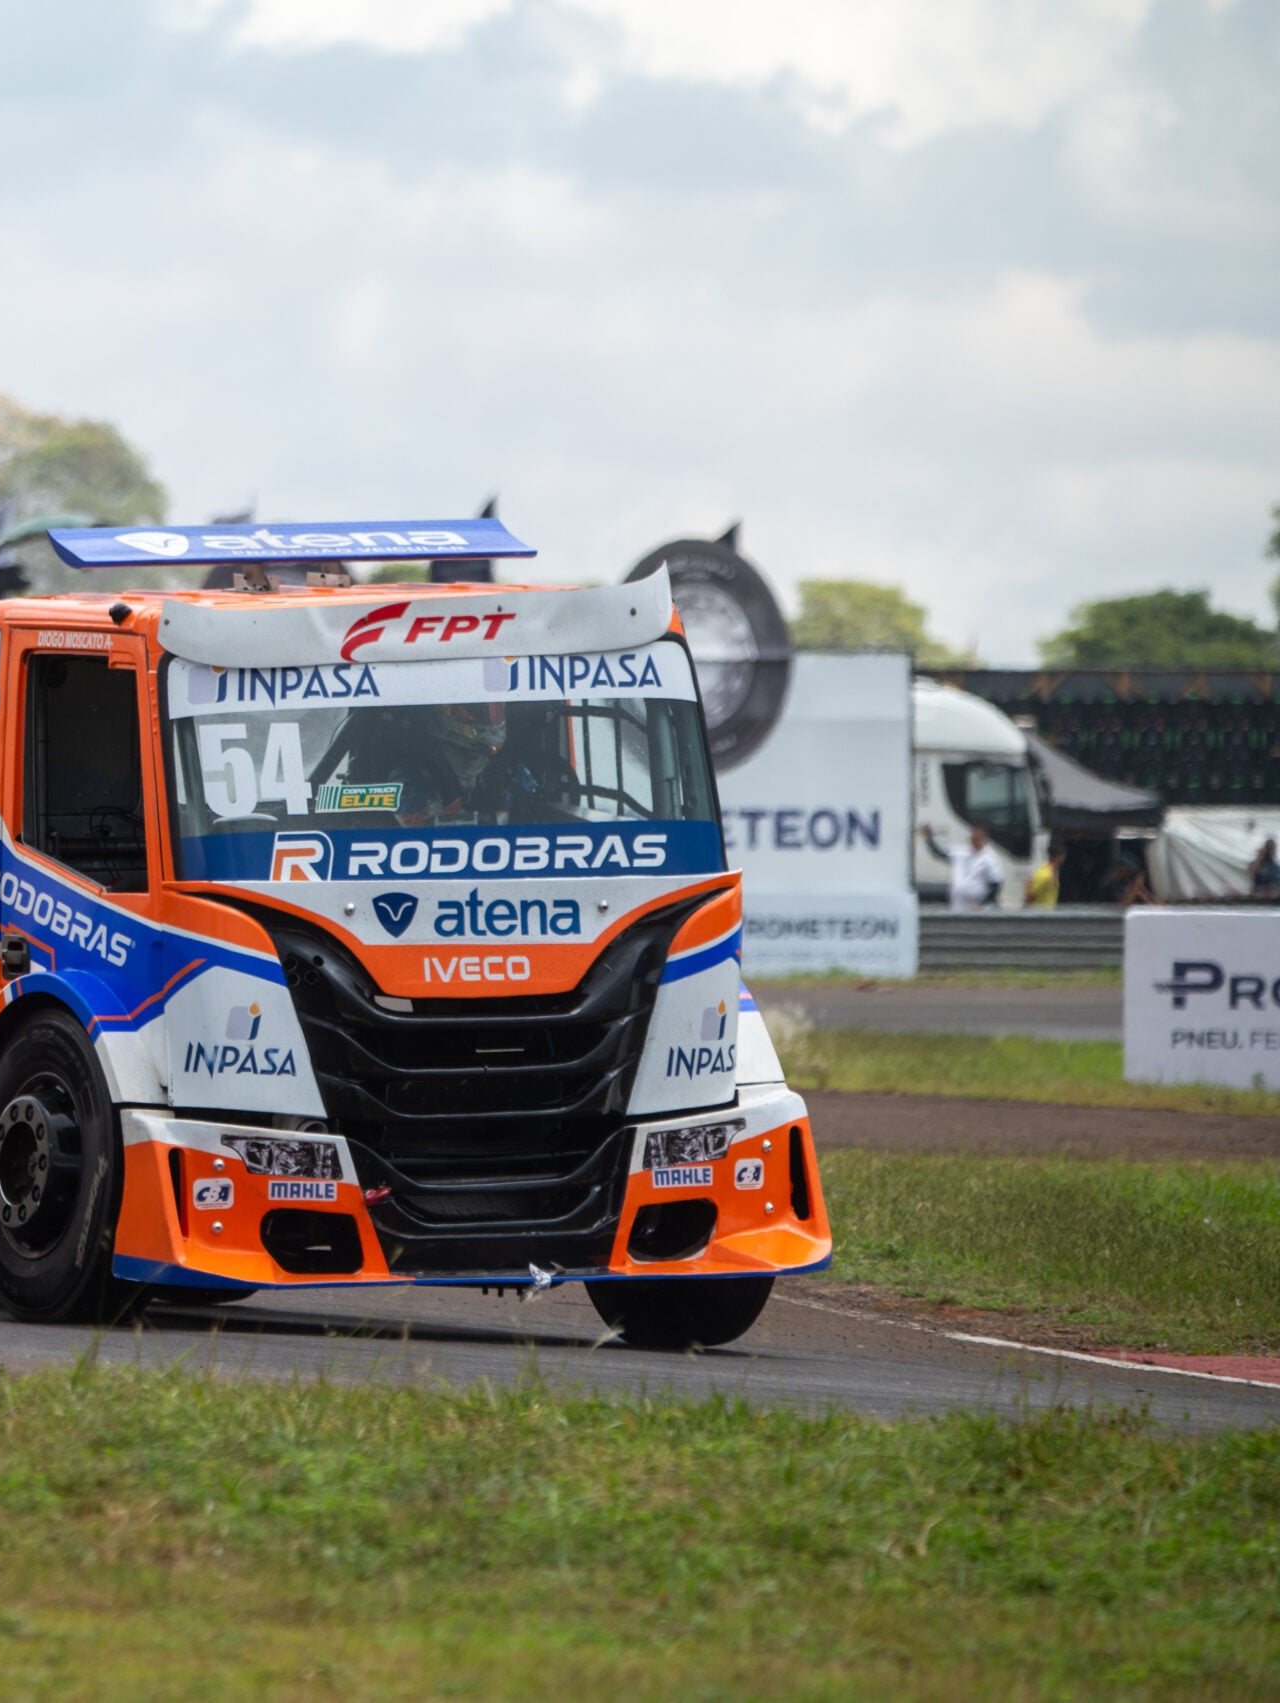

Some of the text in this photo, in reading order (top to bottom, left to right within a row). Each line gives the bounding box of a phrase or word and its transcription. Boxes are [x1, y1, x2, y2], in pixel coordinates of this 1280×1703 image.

[201, 528, 469, 551] atena
[37, 631, 64, 647] DIOGO
[65, 632, 103, 649] MOSCATO
[404, 613, 517, 643] FPT
[238, 663, 381, 708] INPASA
[529, 654, 663, 696] INPASA
[199, 722, 312, 818] 54
[341, 794, 395, 807] ELITE
[348, 834, 668, 877] RODOBRAS
[434, 887, 581, 937] atena
[423, 955, 531, 983] IVECO
[1152, 961, 1280, 1010] PR
[1170, 1031, 1243, 1051] PNEU.
[184, 1041, 297, 1080] INPASA
[271, 1182, 335, 1199] MAHLE
[654, 1168, 712, 1186] MAHLE
